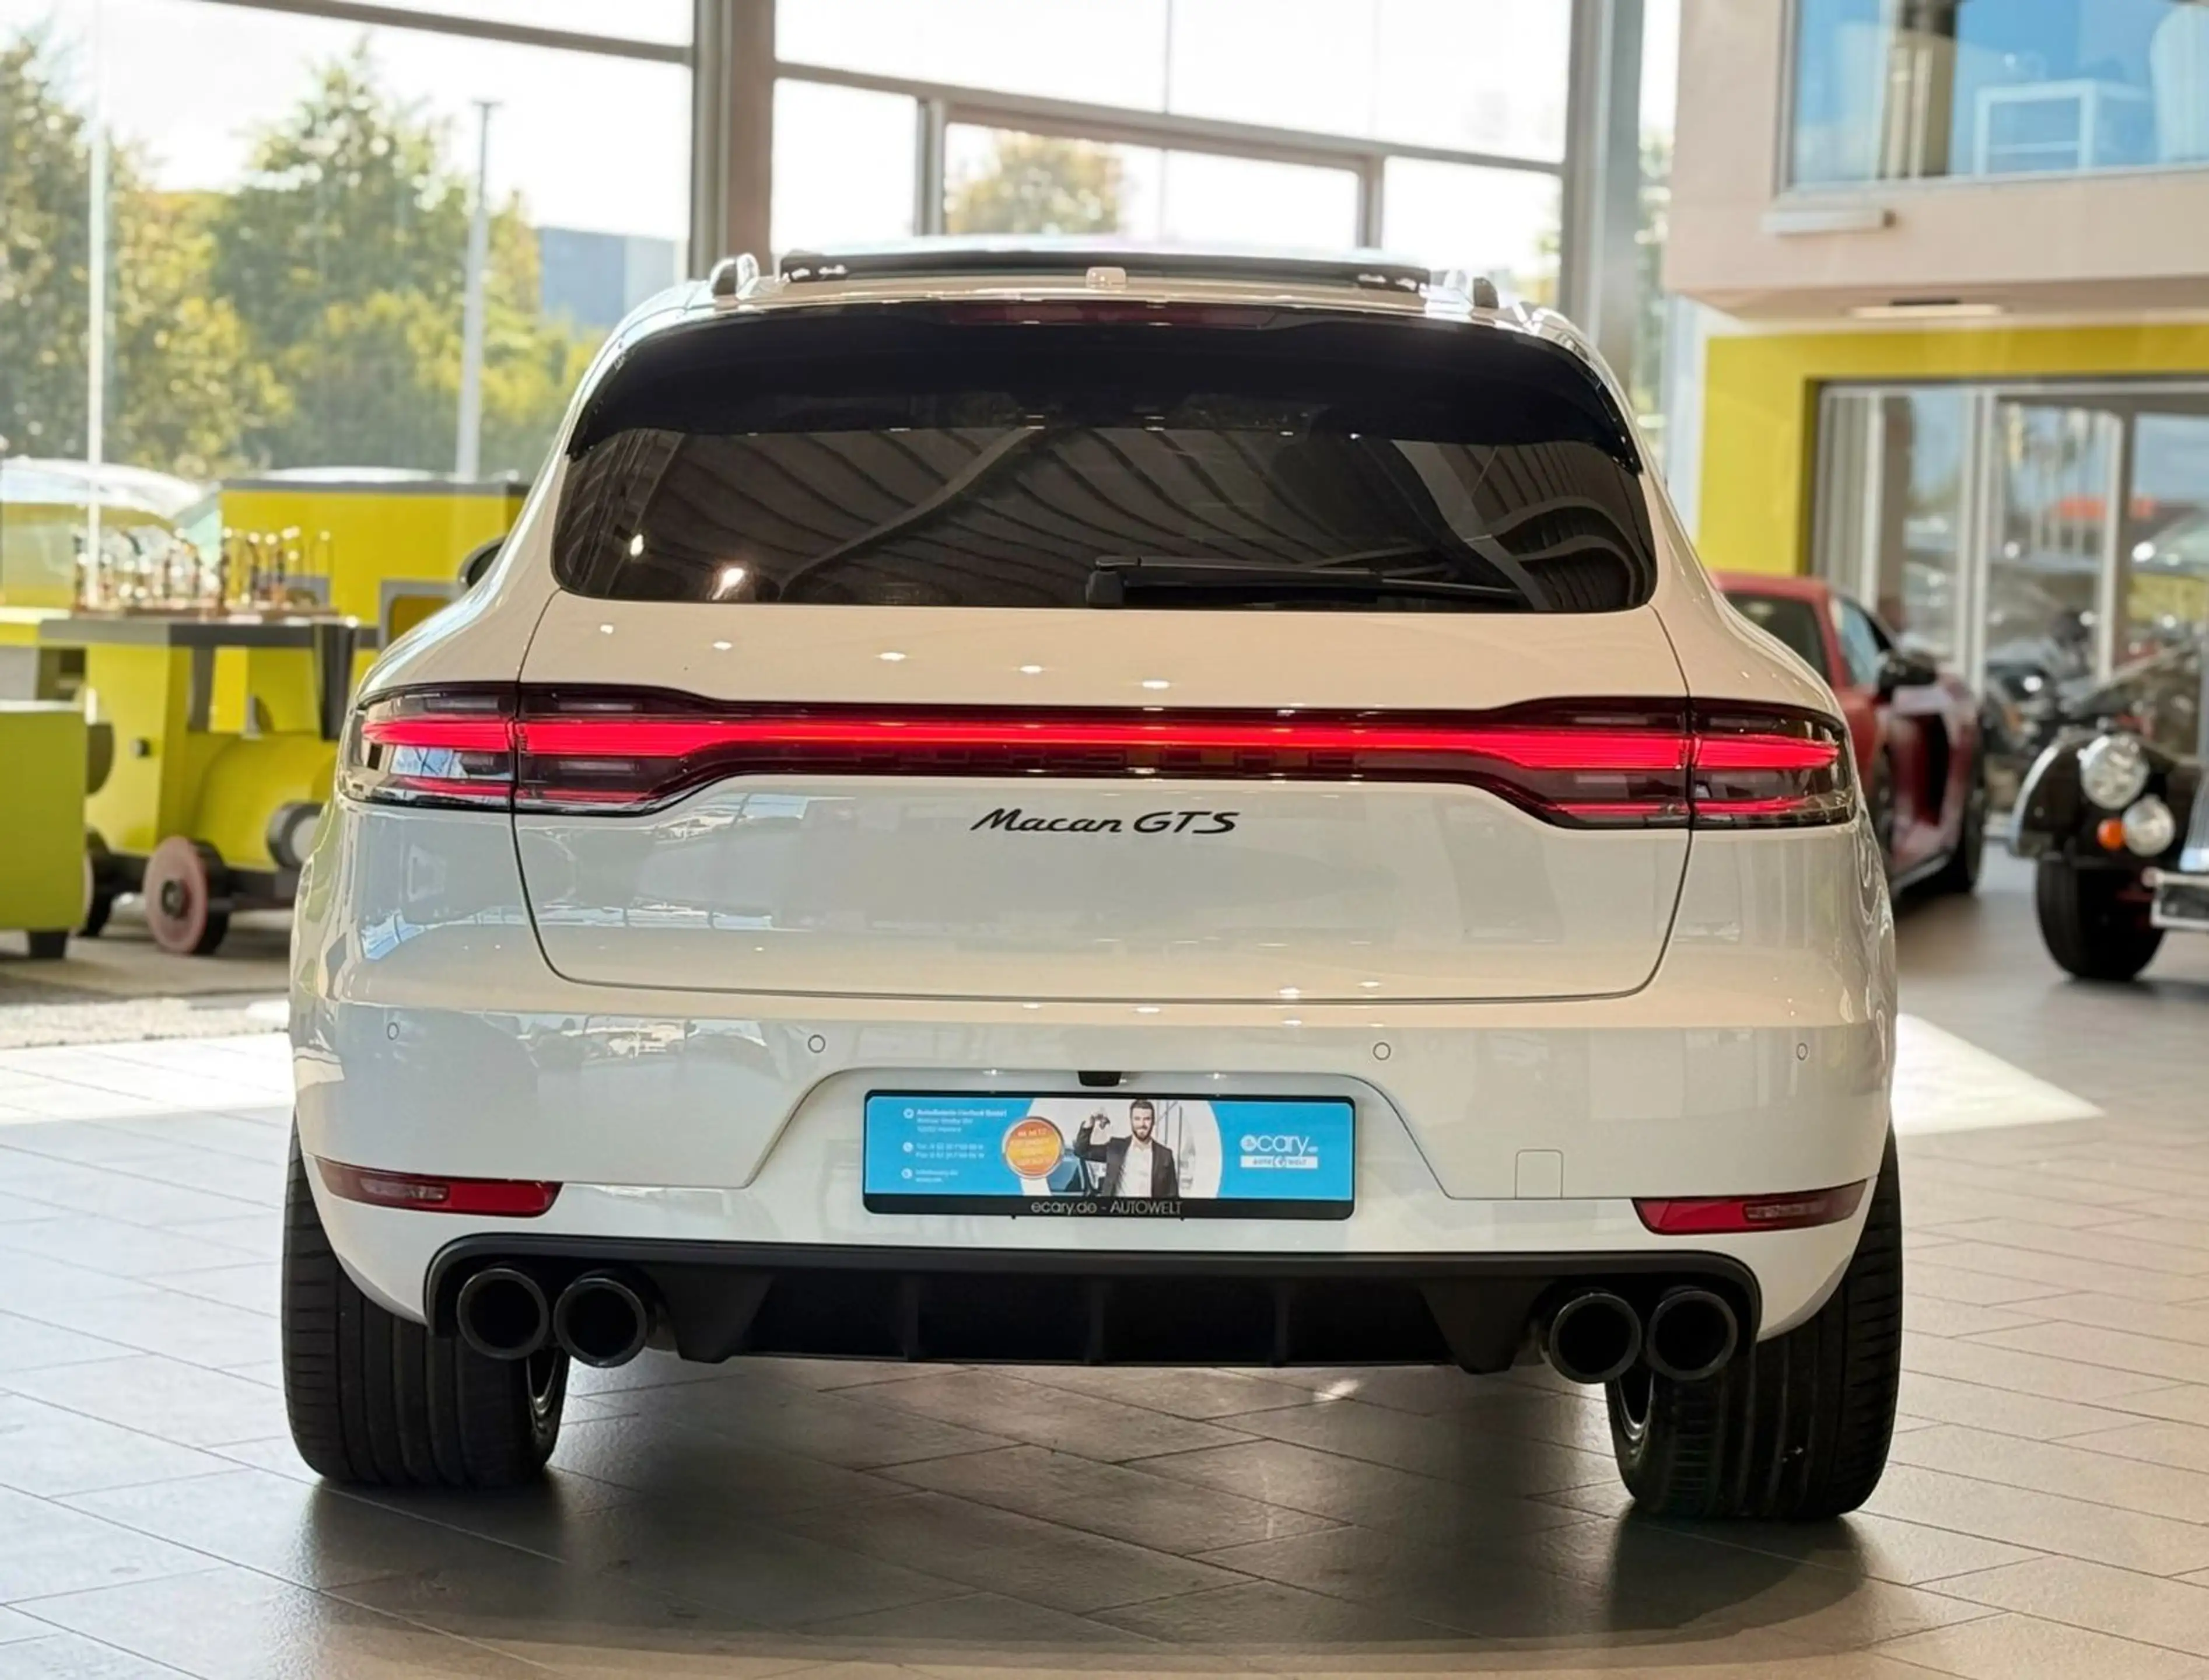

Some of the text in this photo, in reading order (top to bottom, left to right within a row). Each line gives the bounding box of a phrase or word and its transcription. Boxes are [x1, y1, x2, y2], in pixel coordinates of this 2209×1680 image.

[970, 808, 1241, 834] Macan GTS
[1030, 1200, 1098, 1216] ecary.de
[1110, 1200, 1182, 1215] AUTOWELT
